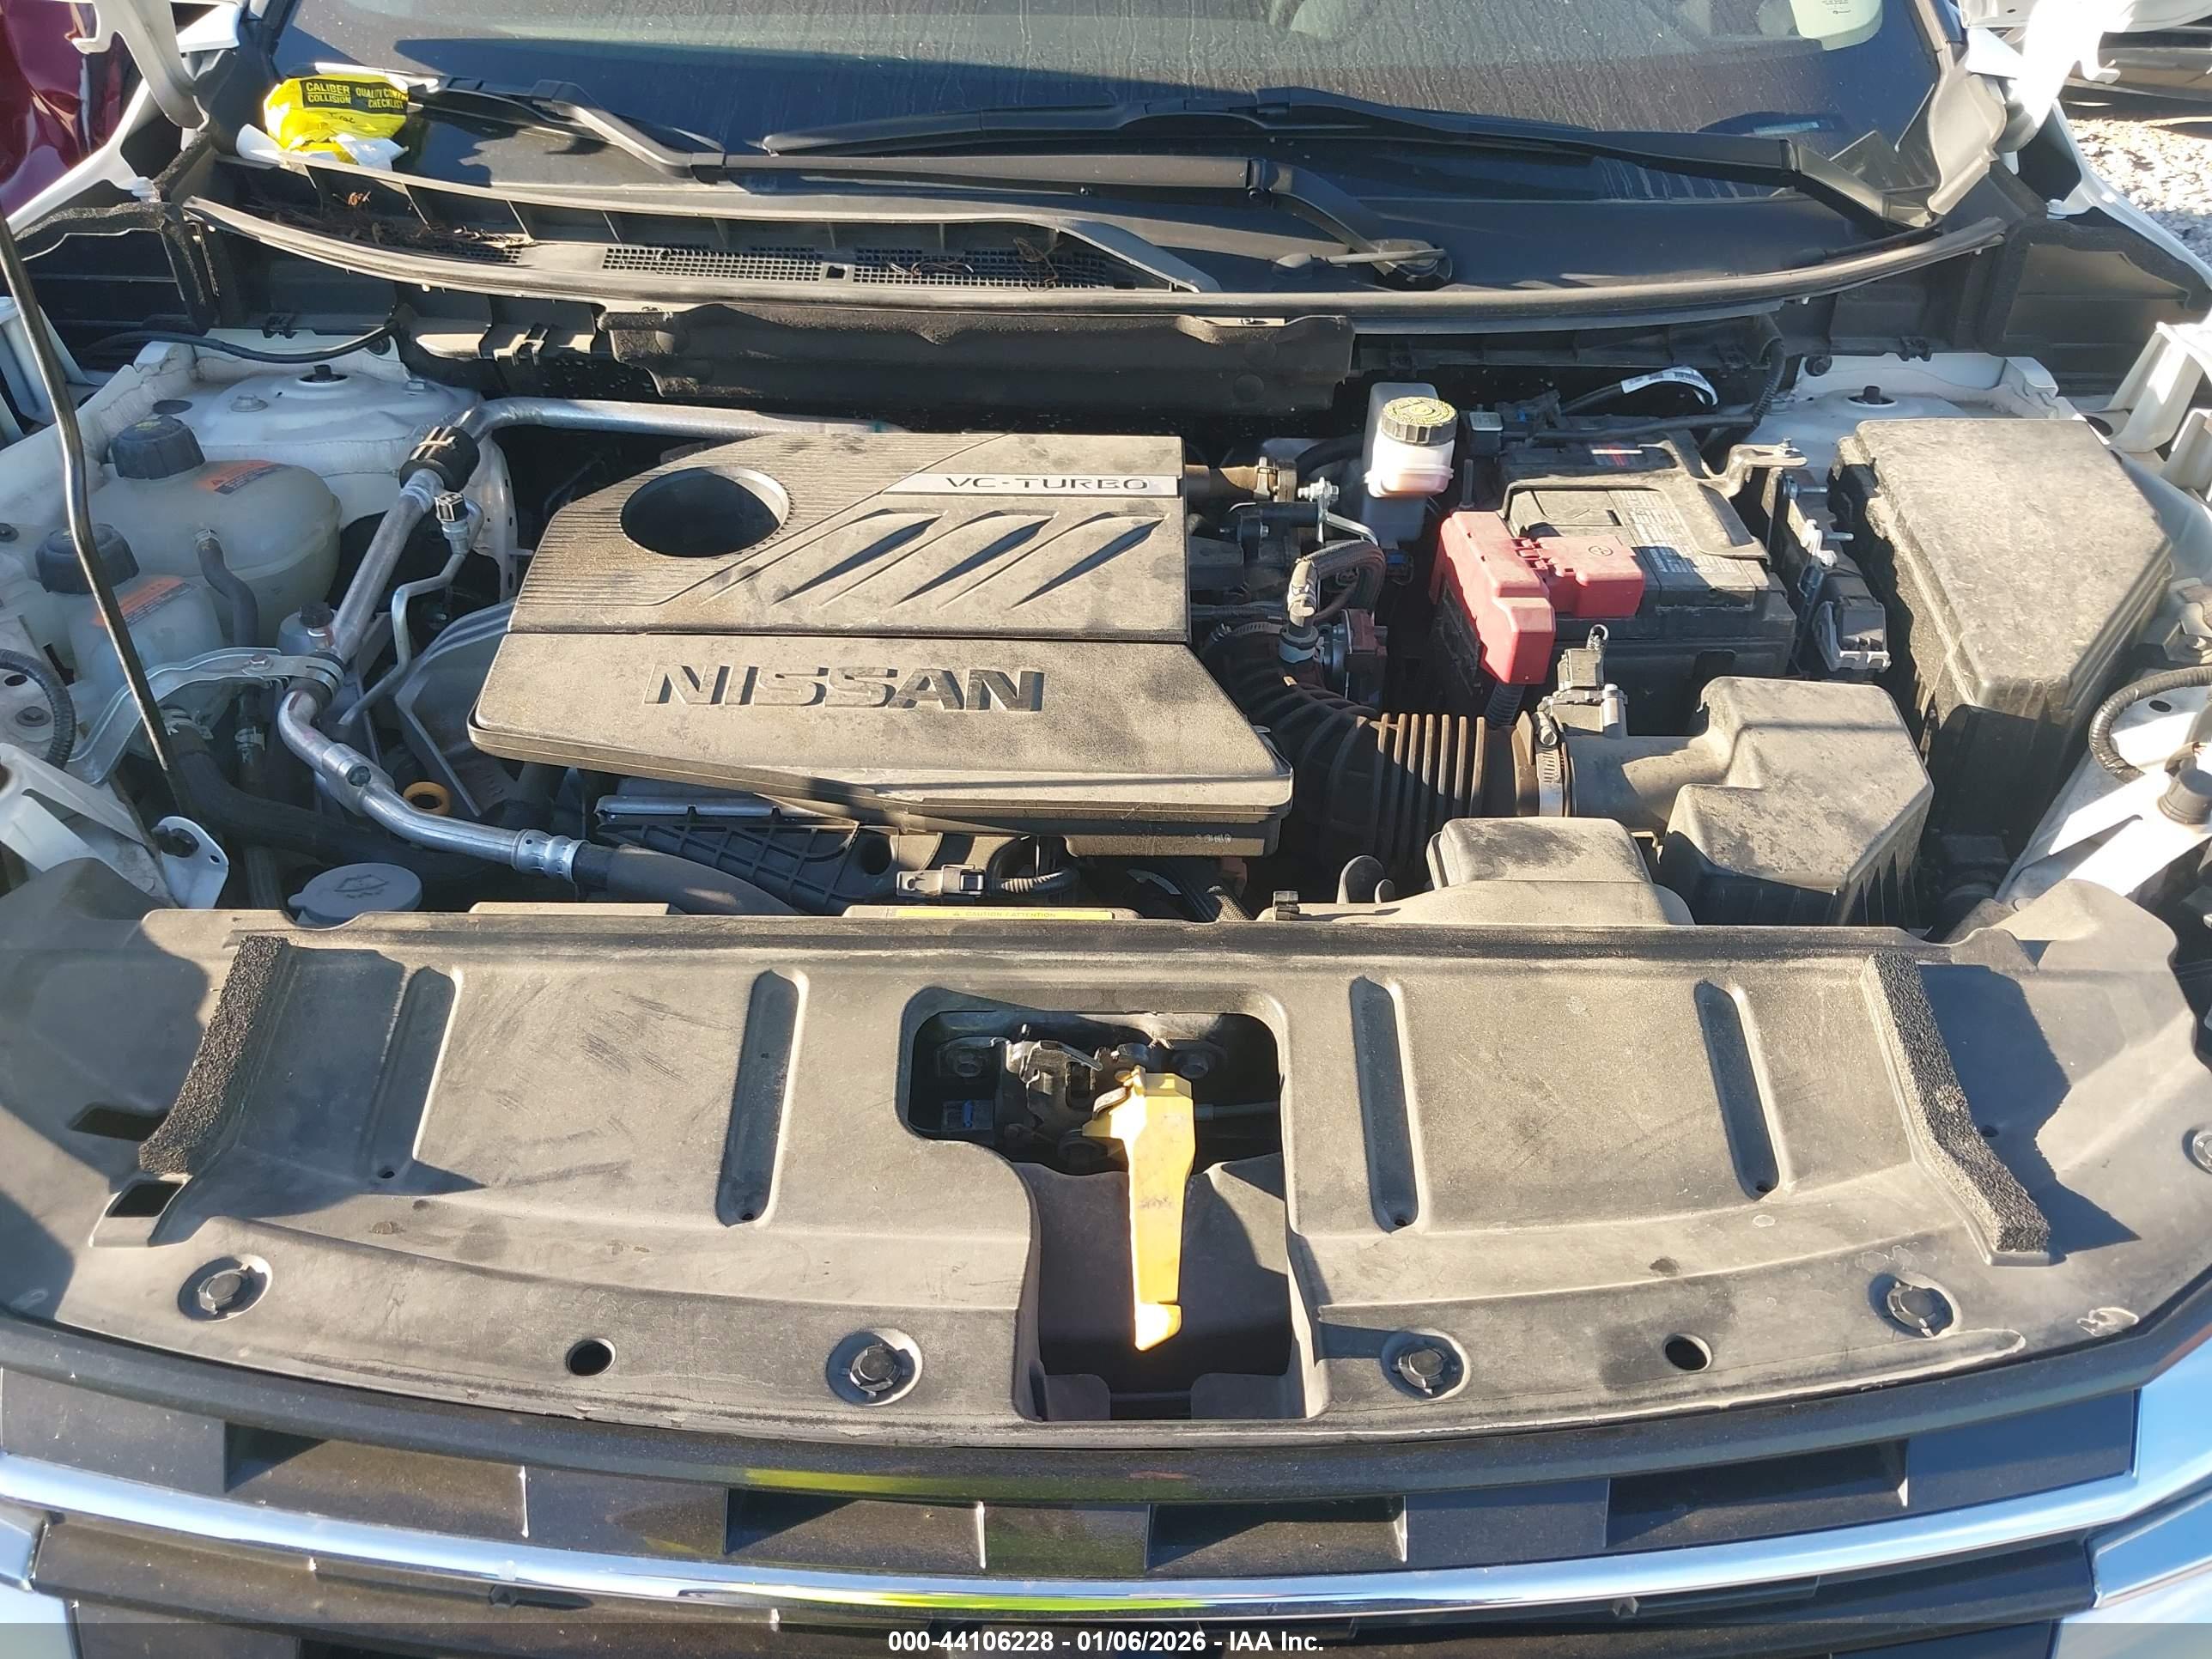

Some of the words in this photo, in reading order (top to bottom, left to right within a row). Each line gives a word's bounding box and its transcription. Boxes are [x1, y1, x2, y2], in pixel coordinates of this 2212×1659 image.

[306, 82, 350, 94] CALIBER
[356, 87, 383, 99] QUALITY
[308, 94, 351, 105] COLLISION
[368, 98, 404, 109] CHECKLIST
[642, 665, 1045, 712] NISSAN
